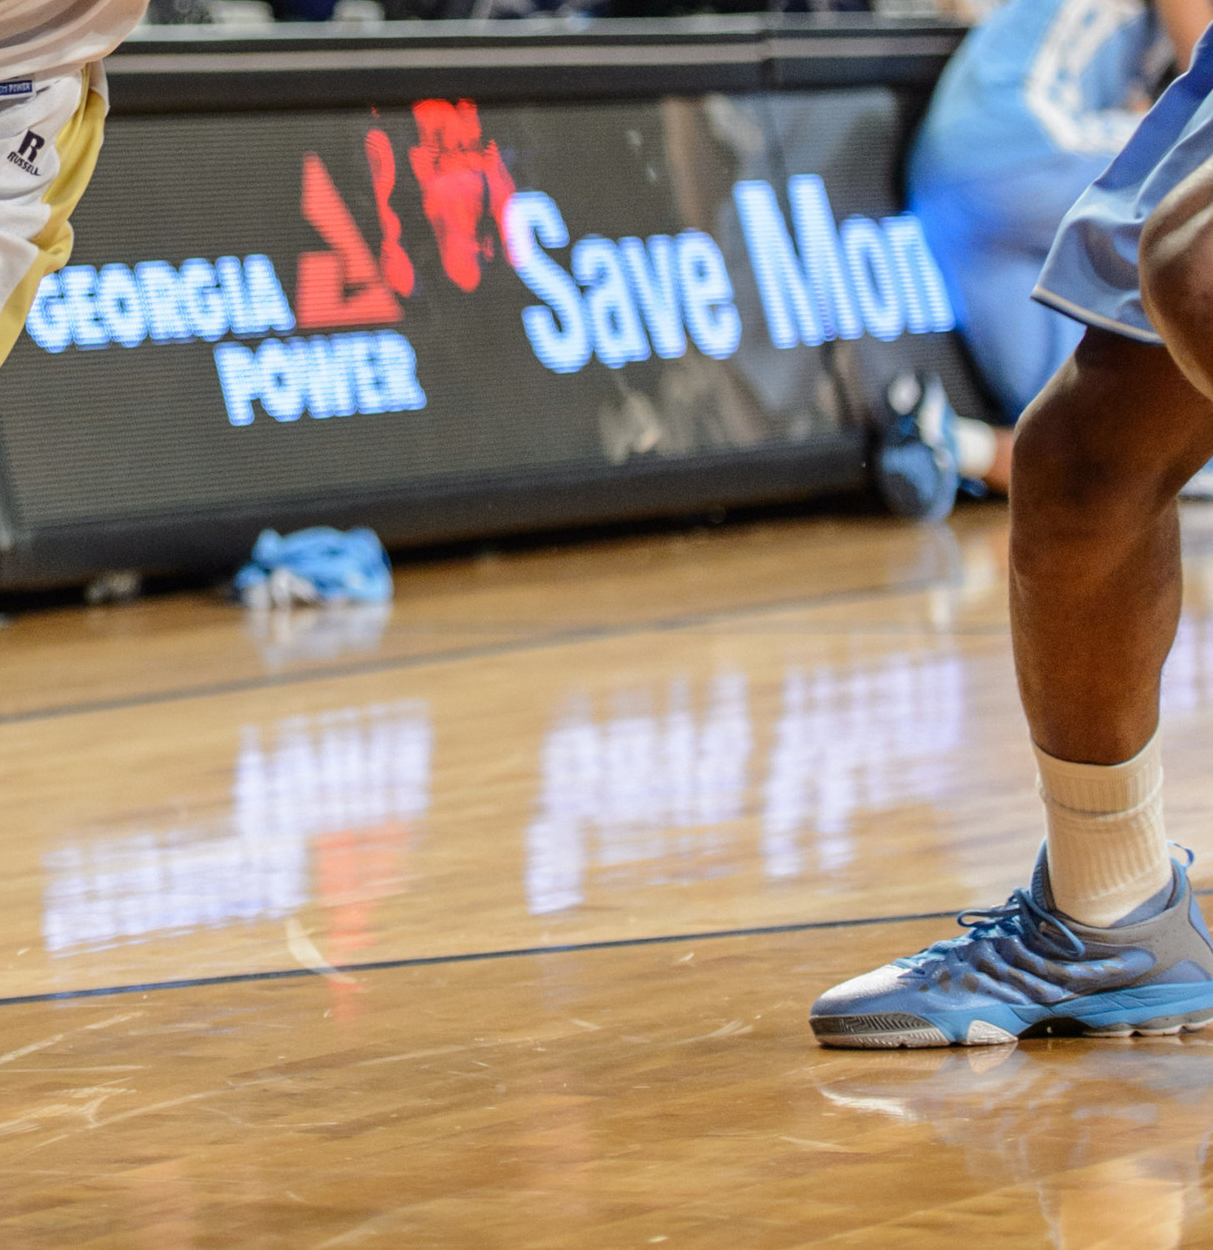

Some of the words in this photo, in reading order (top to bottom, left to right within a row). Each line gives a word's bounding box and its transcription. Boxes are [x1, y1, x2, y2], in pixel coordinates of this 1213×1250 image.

[6, 151, 42, 177] RUSSELL
[25, 253, 297, 354] GEORGIA
[502, 191, 742, 374] Save
[732, 173, 955, 350] Mon
[213, 329, 428, 427] POWER
